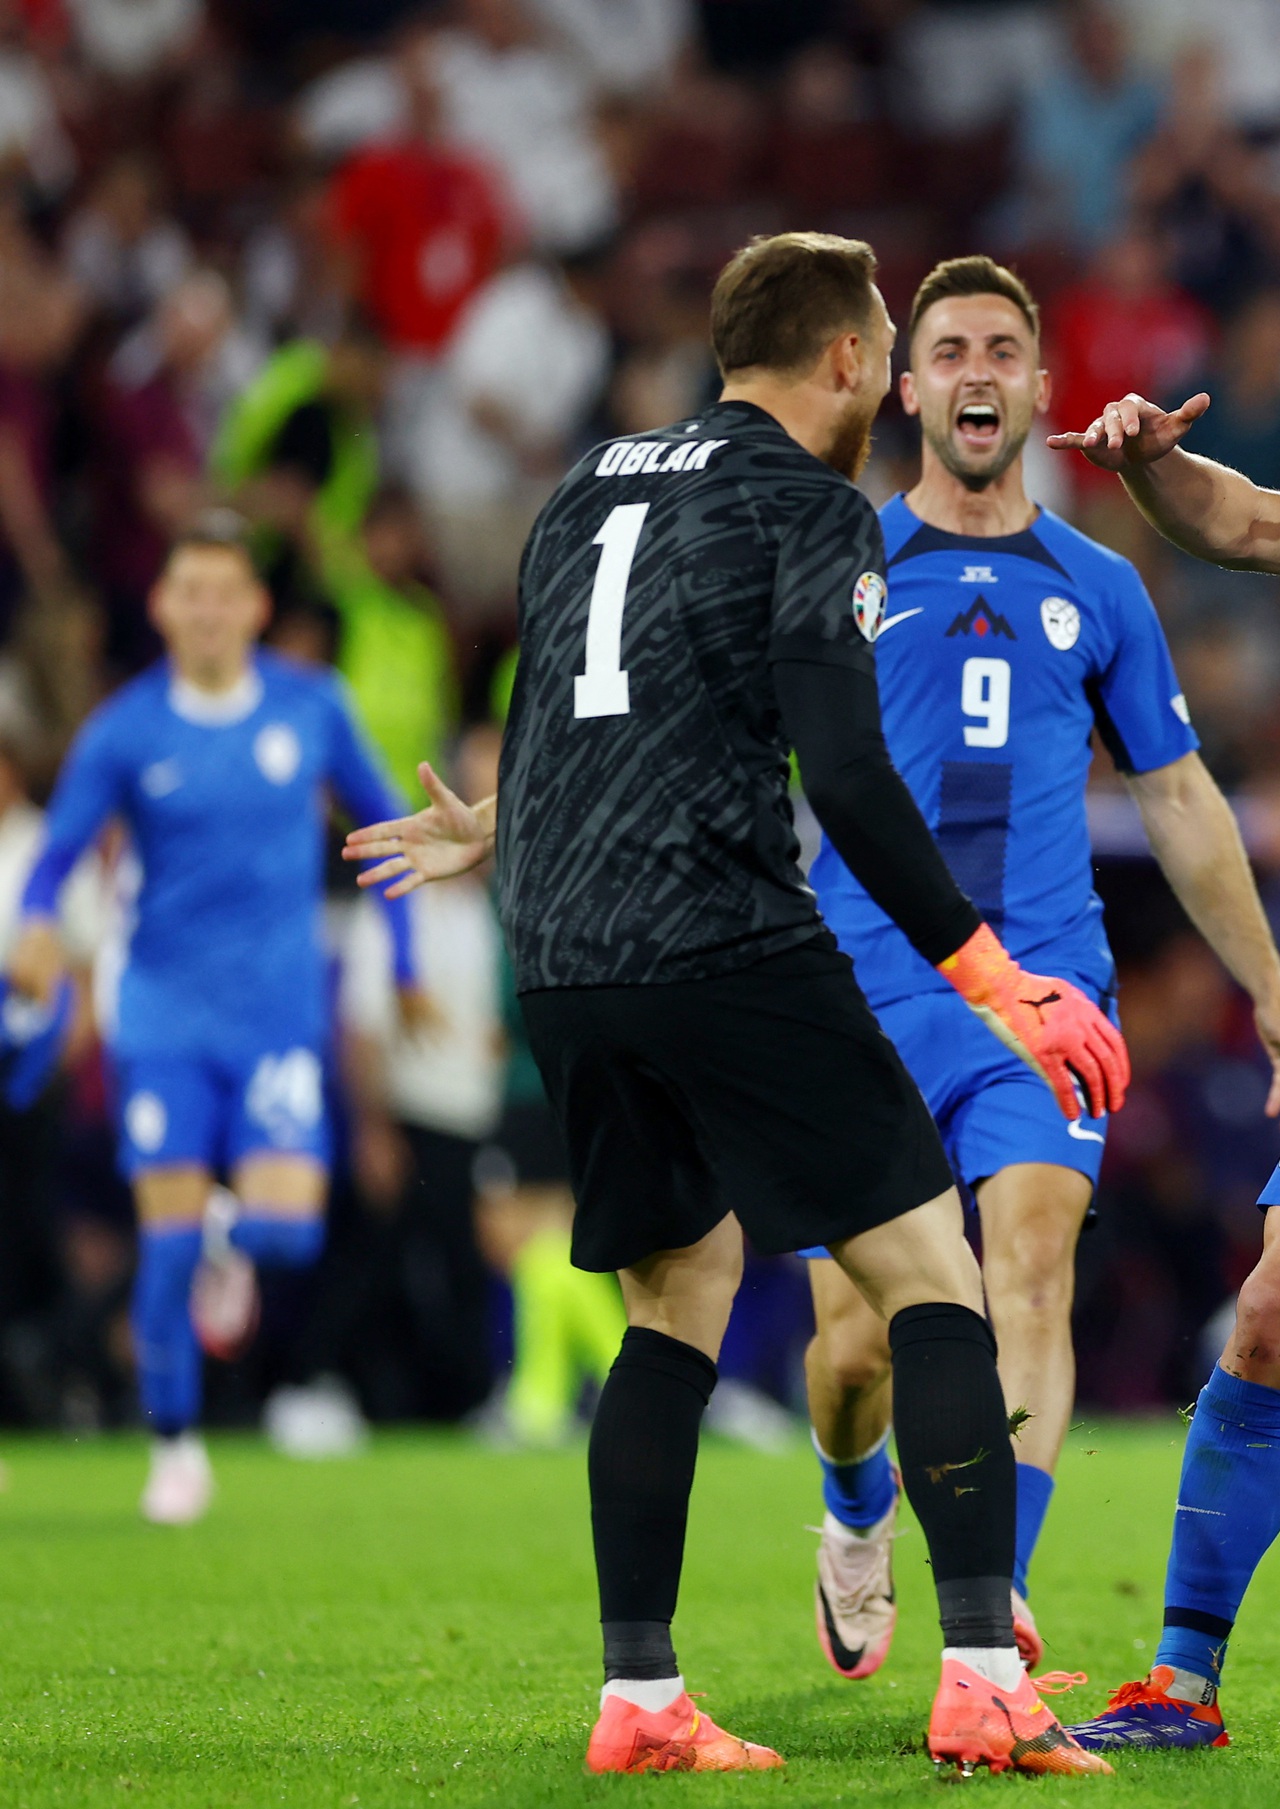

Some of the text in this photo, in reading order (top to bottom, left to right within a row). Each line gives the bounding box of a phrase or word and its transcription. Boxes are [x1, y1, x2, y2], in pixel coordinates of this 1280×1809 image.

[595, 439, 729, 477] OBLAK
[573, 502, 651, 719] 1
[961, 656, 1011, 749] 9
